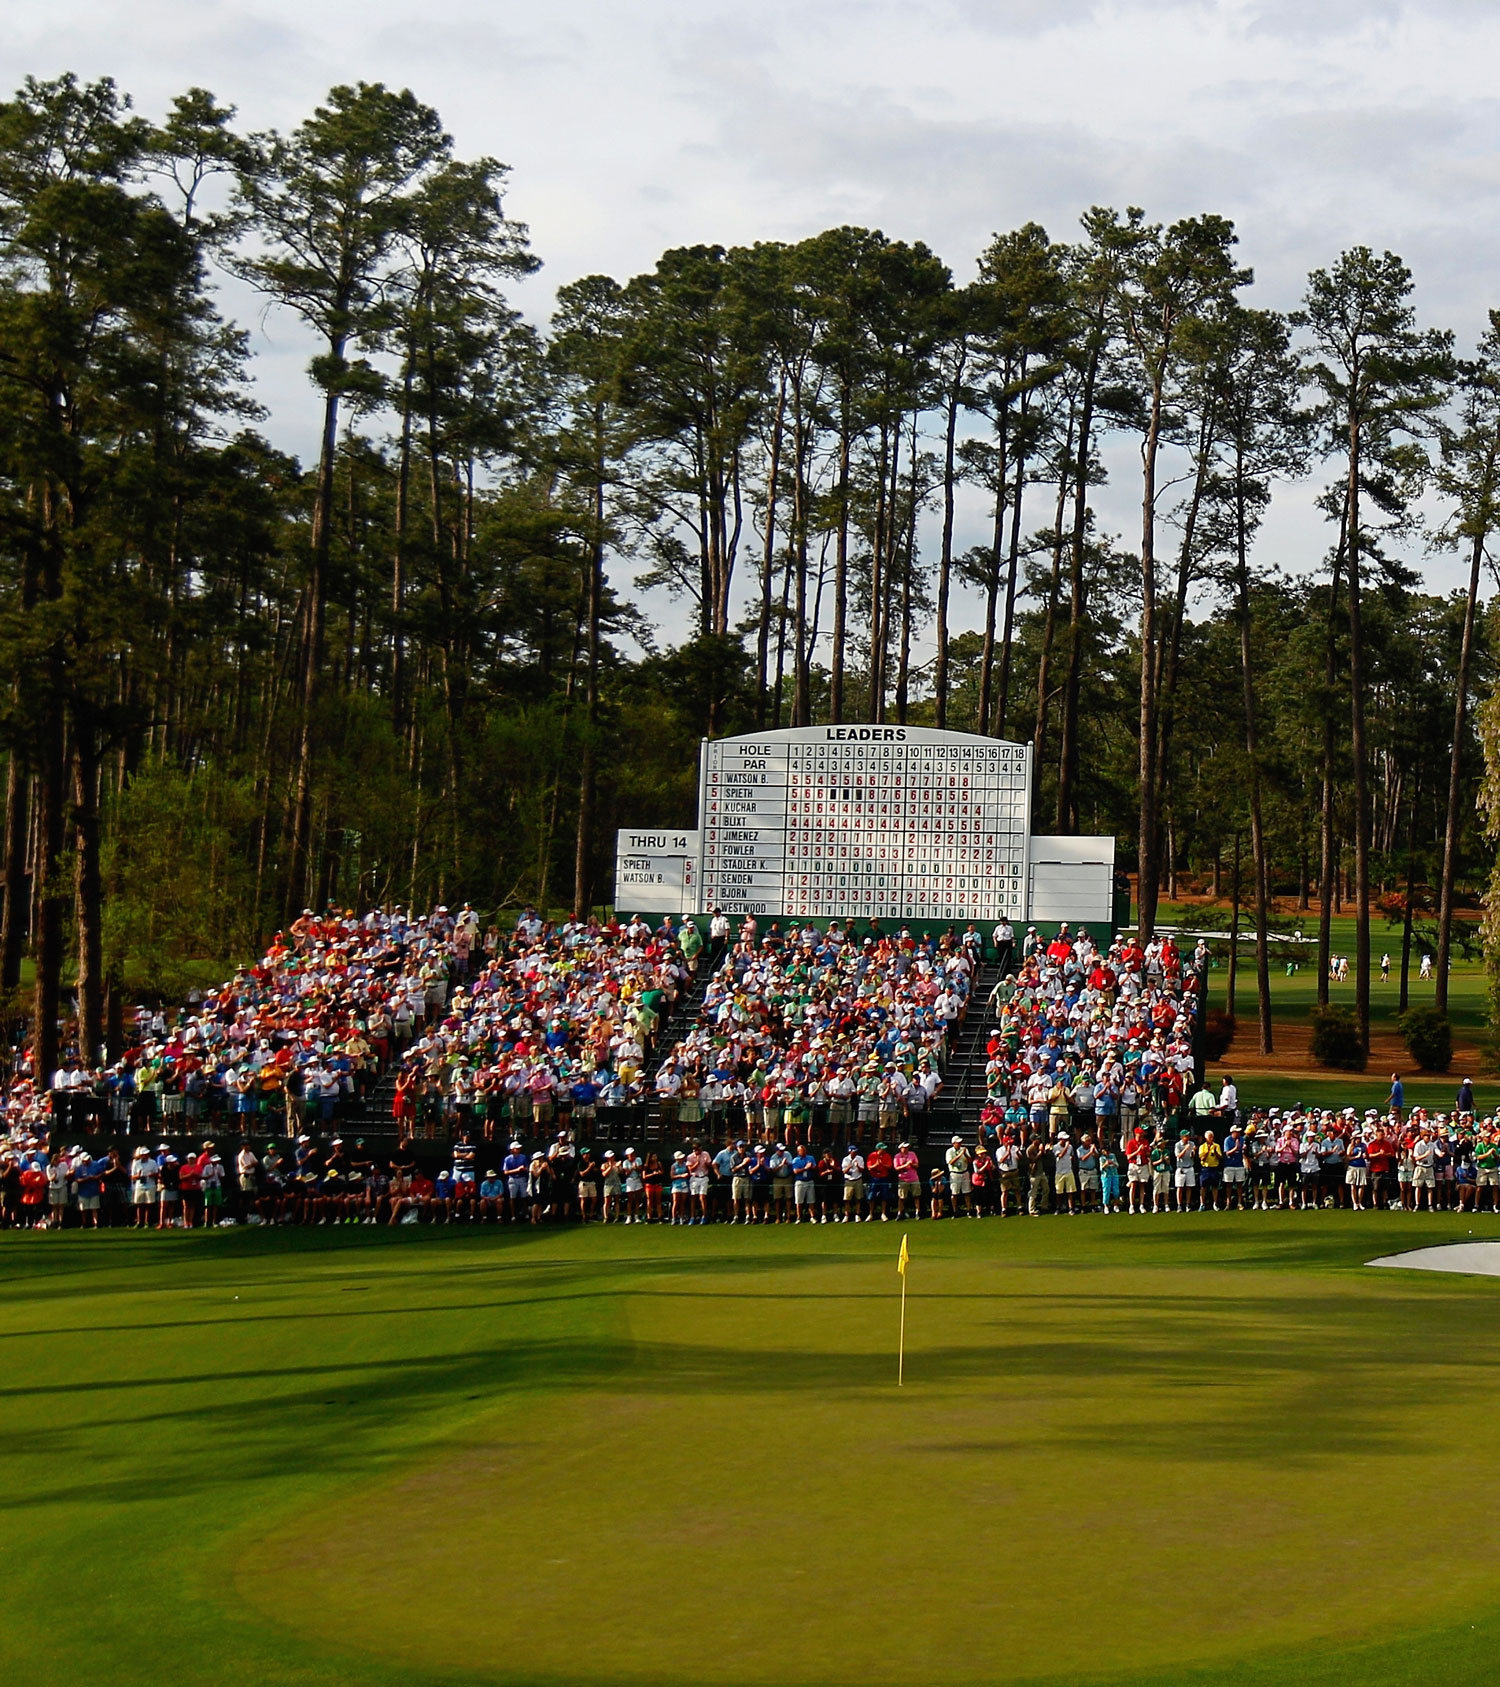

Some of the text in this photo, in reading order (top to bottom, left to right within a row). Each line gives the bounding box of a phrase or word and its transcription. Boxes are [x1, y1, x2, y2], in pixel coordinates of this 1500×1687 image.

[826, 729, 906, 740] LEADERS
[740, 746, 771, 755] HOLE
[806, 746, 812, 756] 2
[819, 746, 825, 756] 3
[832, 747, 838, 756] 4
[845, 747, 851, 756] 5
[858, 747, 864, 757] 6
[871, 747, 876, 757] 7
[883, 747, 889, 757] 8
[897, 747, 903, 757] 9
[910, 747, 919, 757] 10
[924, 748, 932, 757] 11
[936, 748, 945, 758] 12
[949, 748, 958, 758] 13
[962, 748, 971, 758] 14
[975, 748, 984, 758] 15
[988, 748, 997, 758] 16
[1002, 749, 1010, 758] 17
[1015, 749, 1024, 759] 18
[744, 760, 1021, 772] PAR 4 5 4 3 4 3 4 5 4 4 4 3 5 4 5 3 4 4
[712, 774, 968, 787] 5 WATSON B. 5 5 4 5 5 6 6 7 8 7 7 7 8 8
[712, 788, 968, 801] 5 SPIETH 5 6 6 8 7 6 6 6 5 5 5
[711, 802, 981, 816] 4 KUCHAR 4 5 6 4 4 4 4 4 3 3 4 4 4 4 4
[710, 816, 980, 830] 4 BLIXT 4 4 4 4 4 4 3 4 4 4 4 4 5 5 5
[629, 836, 687, 848] THRU 14
[710, 831, 716, 840] 3
[724, 832, 758, 841] JIMENEZ
[790, 832, 796, 841] 2
[803, 832, 809, 842] 3
[816, 832, 822, 842] 2
[828, 832, 835, 842] 2
[909, 833, 915, 843] 2
[934, 834, 940, 844] 2
[948, 834, 954, 844] 2
[961, 835, 967, 845] 3
[974, 835, 980, 845] 3
[987, 835, 992, 845] 4
[709, 845, 715, 854] 3
[723, 846, 755, 855] FOWLER
[790, 846, 795, 856] 4
[802, 846, 808, 856] 3
[815, 846, 821, 856] 3
[828, 846, 834, 856] 3
[841, 847, 846, 857] 3
[854, 847, 860, 857] 3
[866, 847, 872, 858] 3
[880, 848, 886, 858] 3
[892, 848, 898, 858] 3
[908, 848, 914, 858] 2
[960, 849, 966, 859] 2
[973, 849, 980, 859] 2
[986, 849, 993, 860] 2
[624, 860, 691, 871] SPIETH 5
[723, 860, 757, 870] STADLER
[760, 861, 768, 870] K.
[623, 874, 691, 884] WATSON B. 8
[722, 874, 752, 884] SENDEN
[707, 889, 747, 898] 2 BJORN
[707, 903, 766, 913] 2 WESTWOOD
